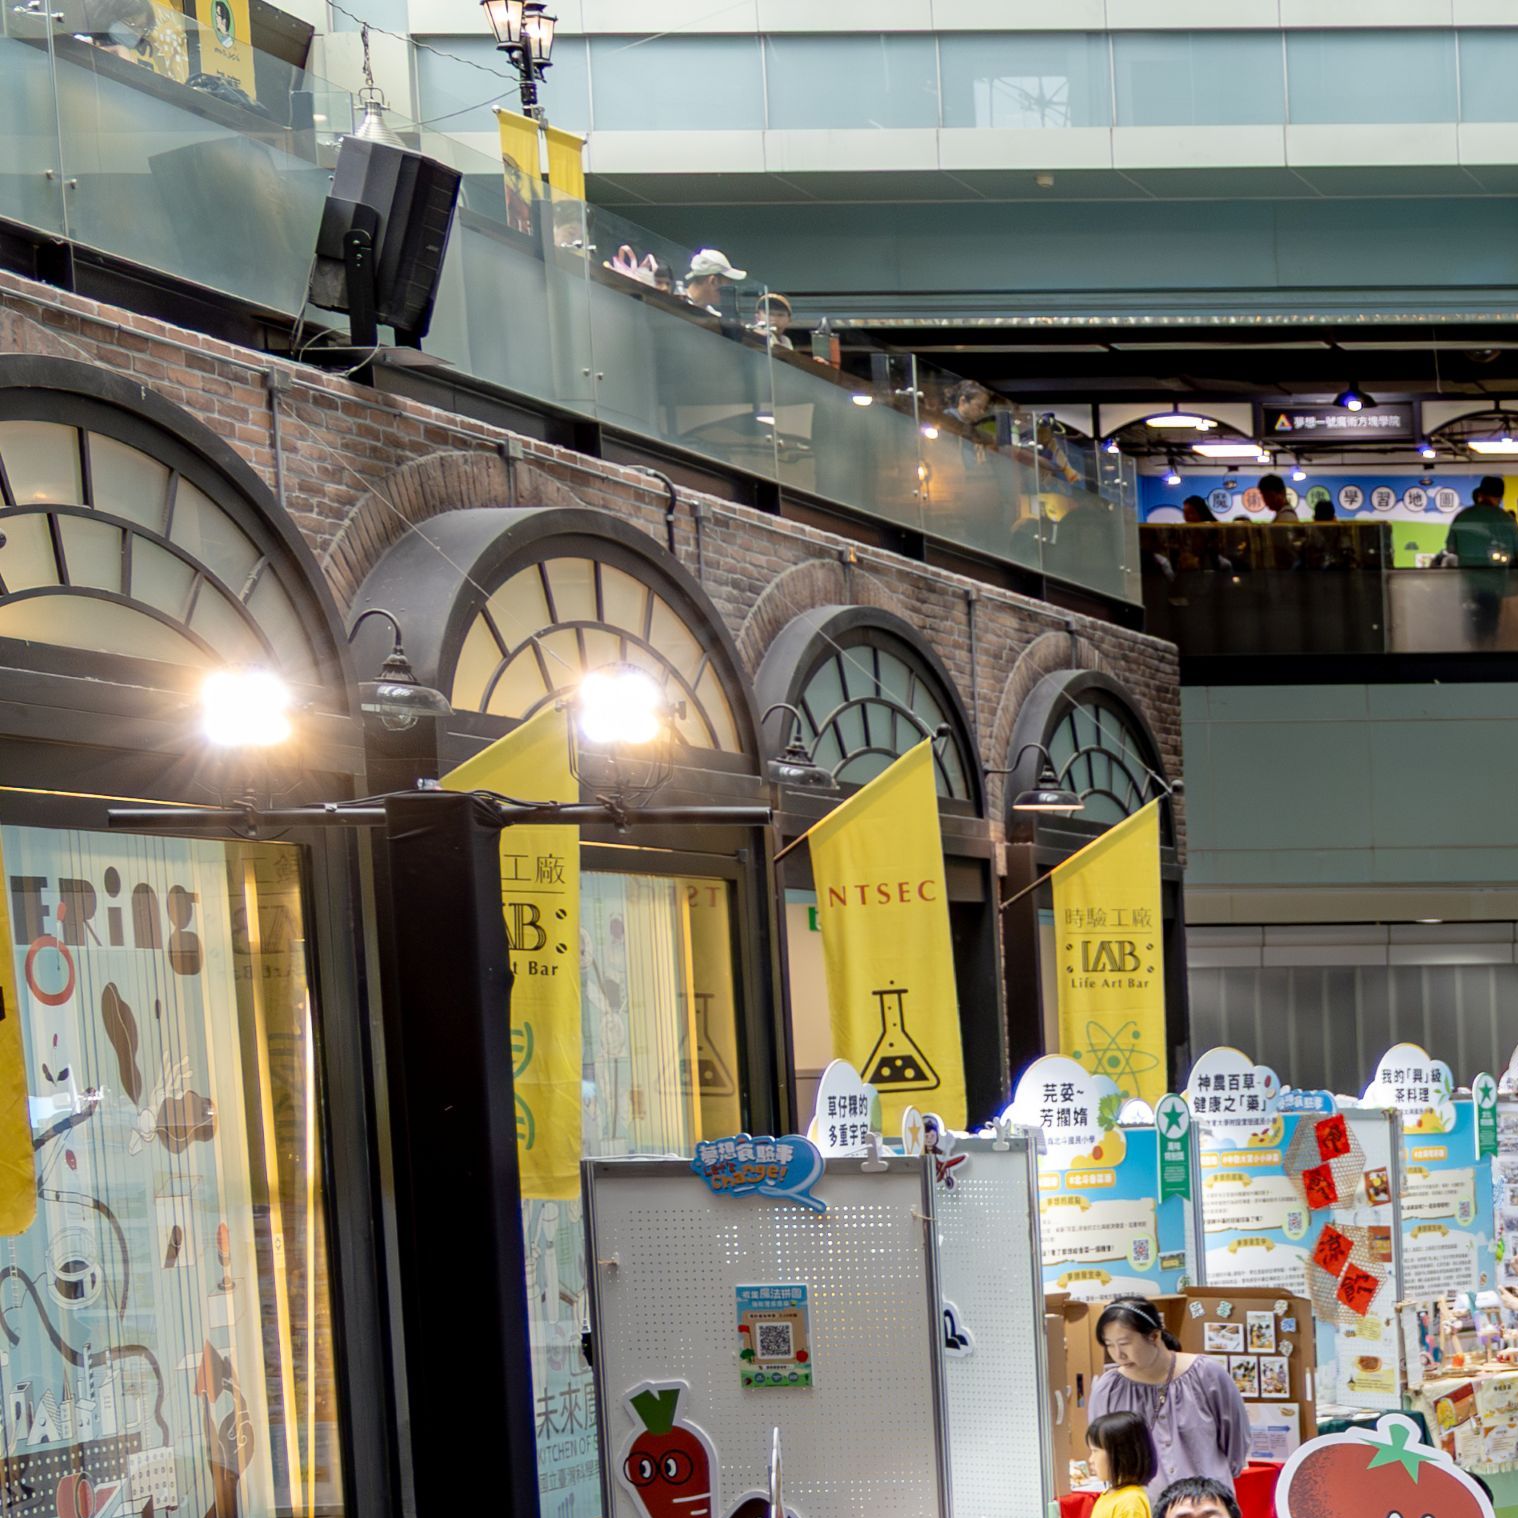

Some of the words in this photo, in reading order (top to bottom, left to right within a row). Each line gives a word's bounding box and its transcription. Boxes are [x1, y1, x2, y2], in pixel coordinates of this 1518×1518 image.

[828, 880, 936, 907] NTSEC
[1065, 908, 1153, 929] 時驗工廠
[528, 960, 559, 976] Bar
[1070, 977, 1096, 989] Life
[1101, 978, 1123, 988] Art
[1128, 978, 1149, 988] Bar
[1394, 1087, 1430, 1103] 茶料理
